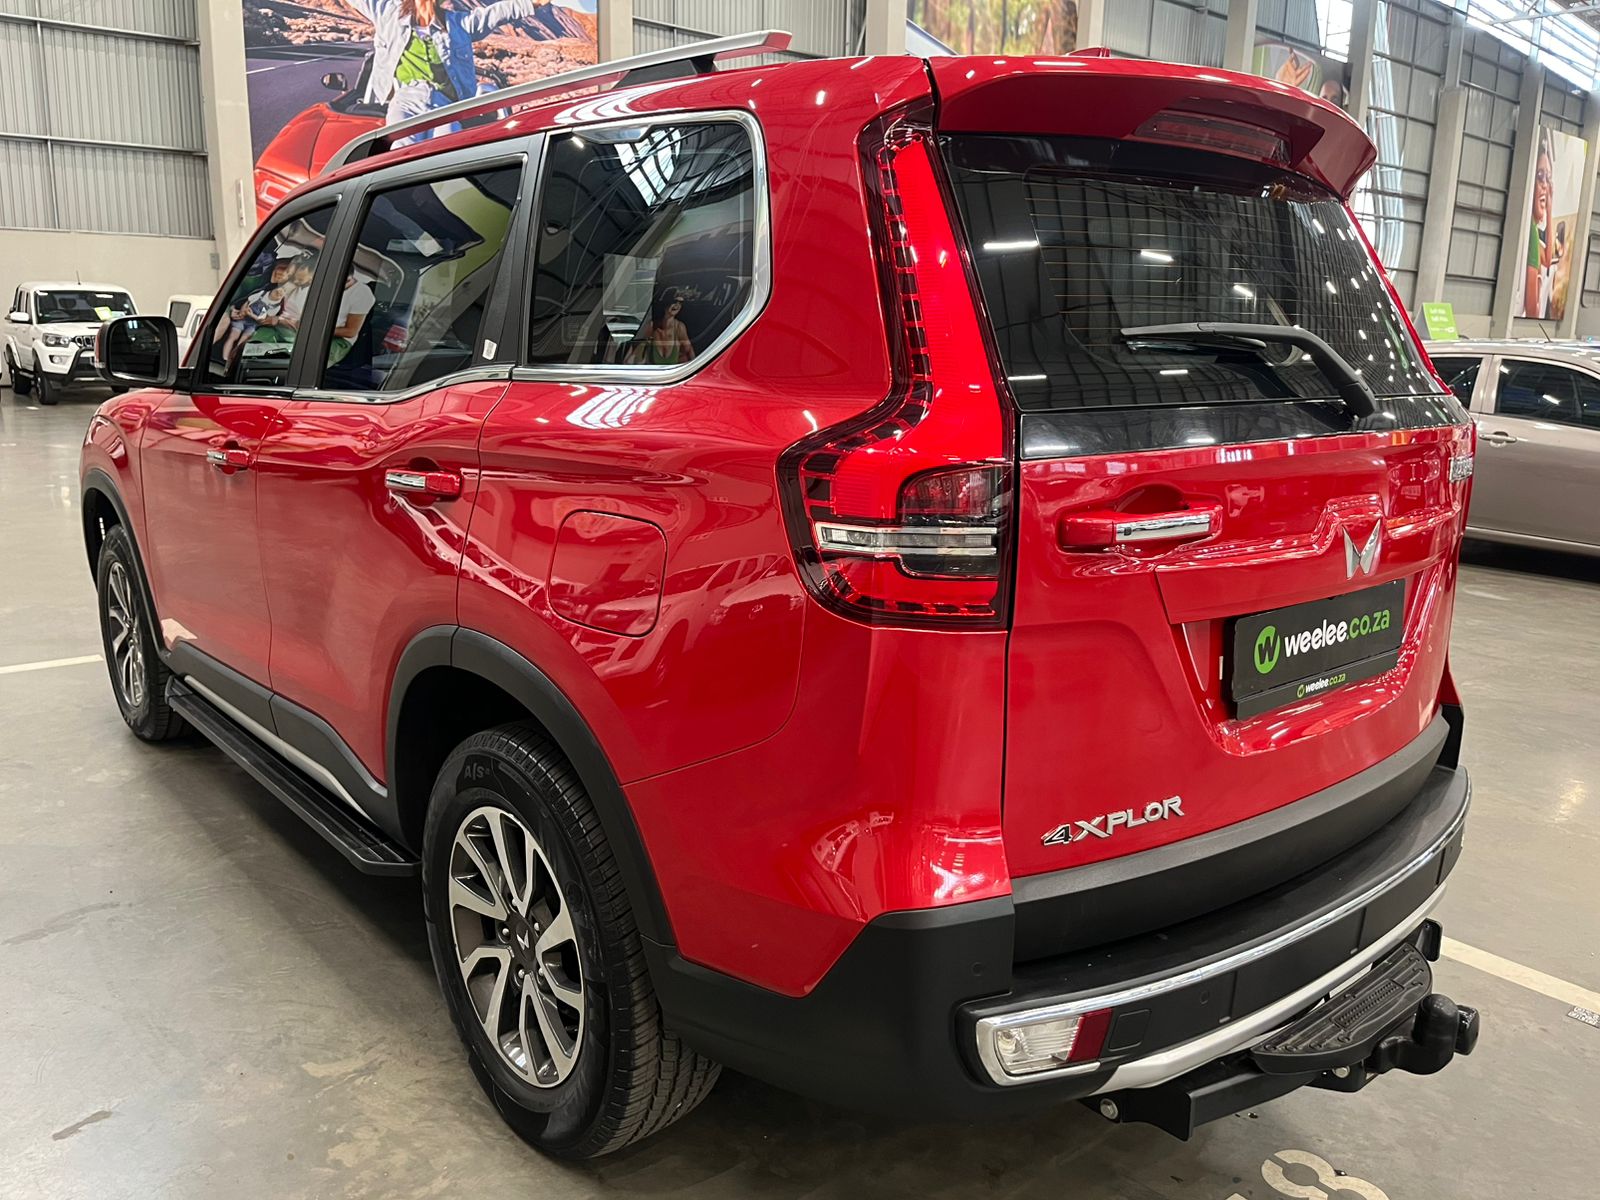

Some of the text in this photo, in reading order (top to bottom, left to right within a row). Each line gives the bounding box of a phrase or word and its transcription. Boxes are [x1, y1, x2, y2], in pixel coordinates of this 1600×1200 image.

[1284, 609, 1391, 658] weelee.co.za
[1305, 673, 1346, 694] weelee.co.za
[1040, 795, 1185, 846] 4XPLOR
